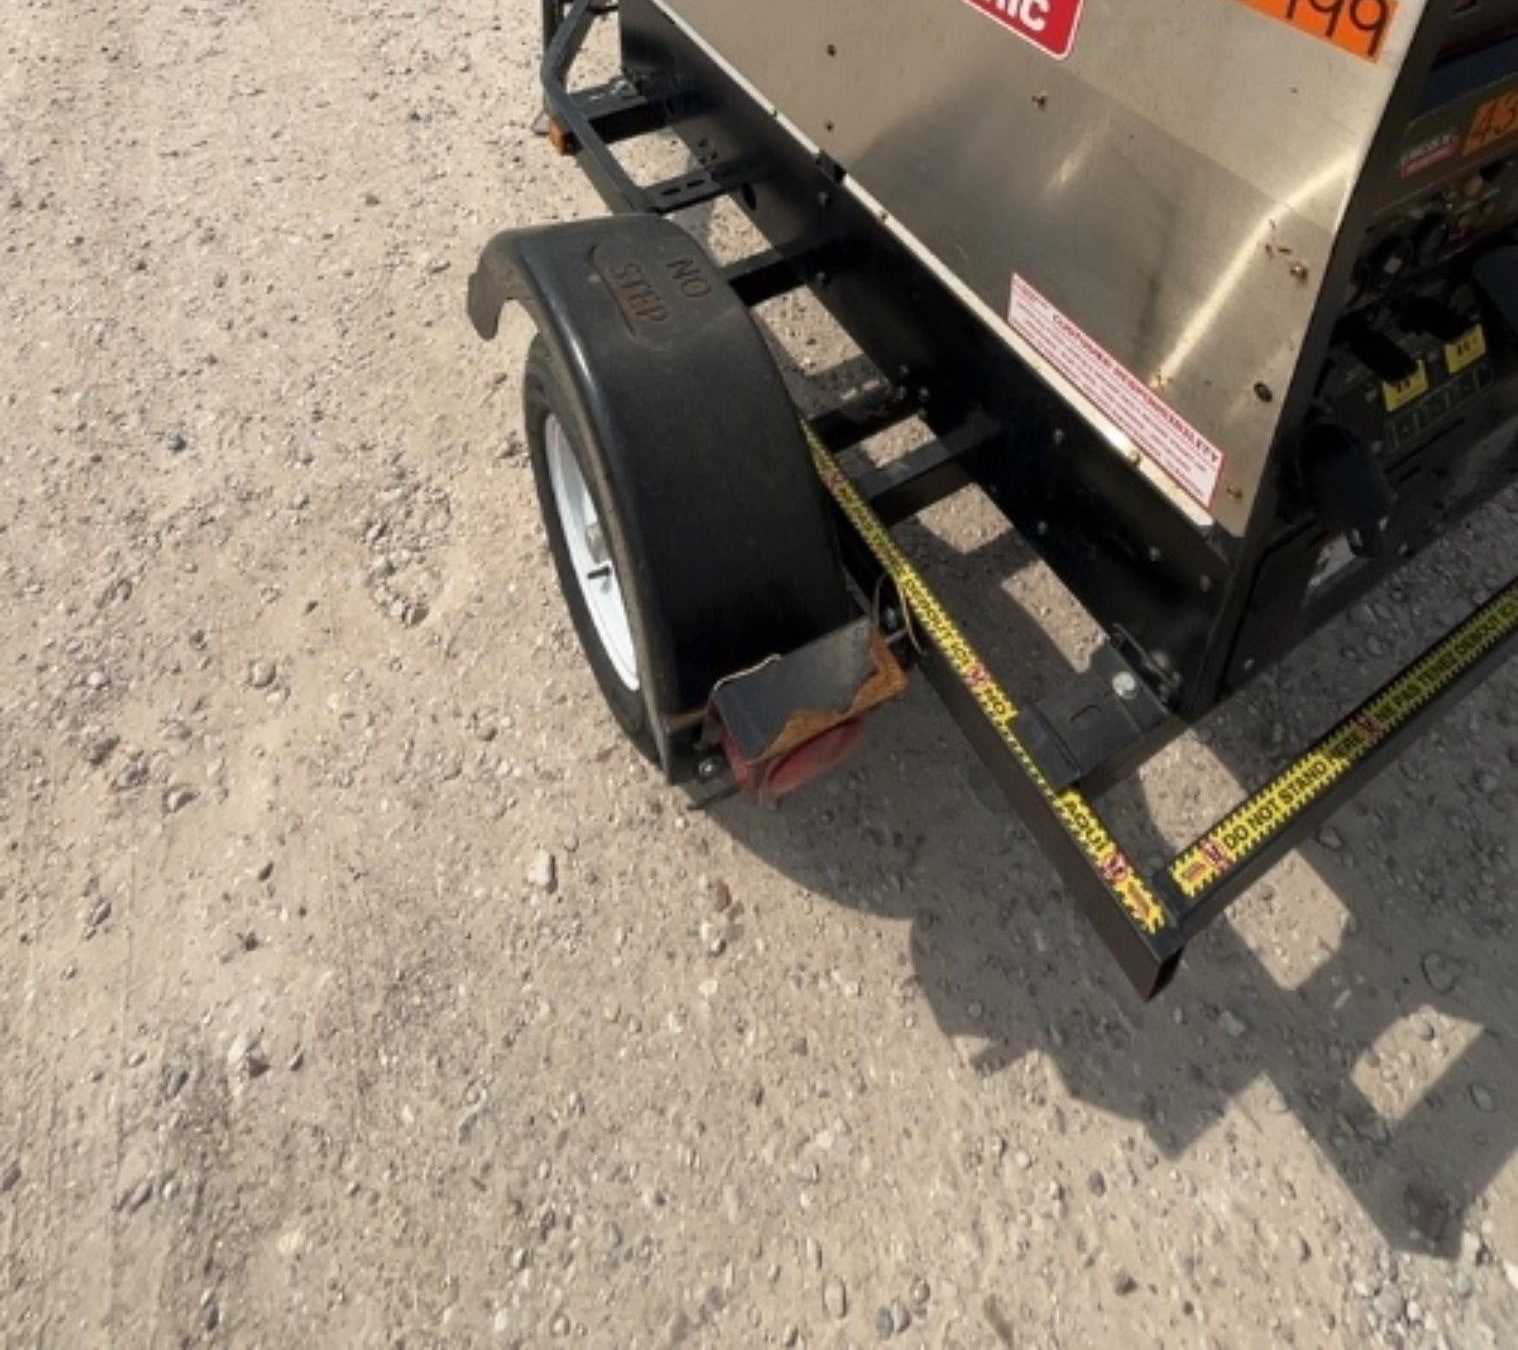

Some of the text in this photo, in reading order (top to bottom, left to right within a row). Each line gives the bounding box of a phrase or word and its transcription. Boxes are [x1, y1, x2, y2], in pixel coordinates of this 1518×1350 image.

[608, 261, 670, 324] STEP
[666, 258, 713, 299] NO
[1222, 760, 1327, 850] DO NOT STAND
